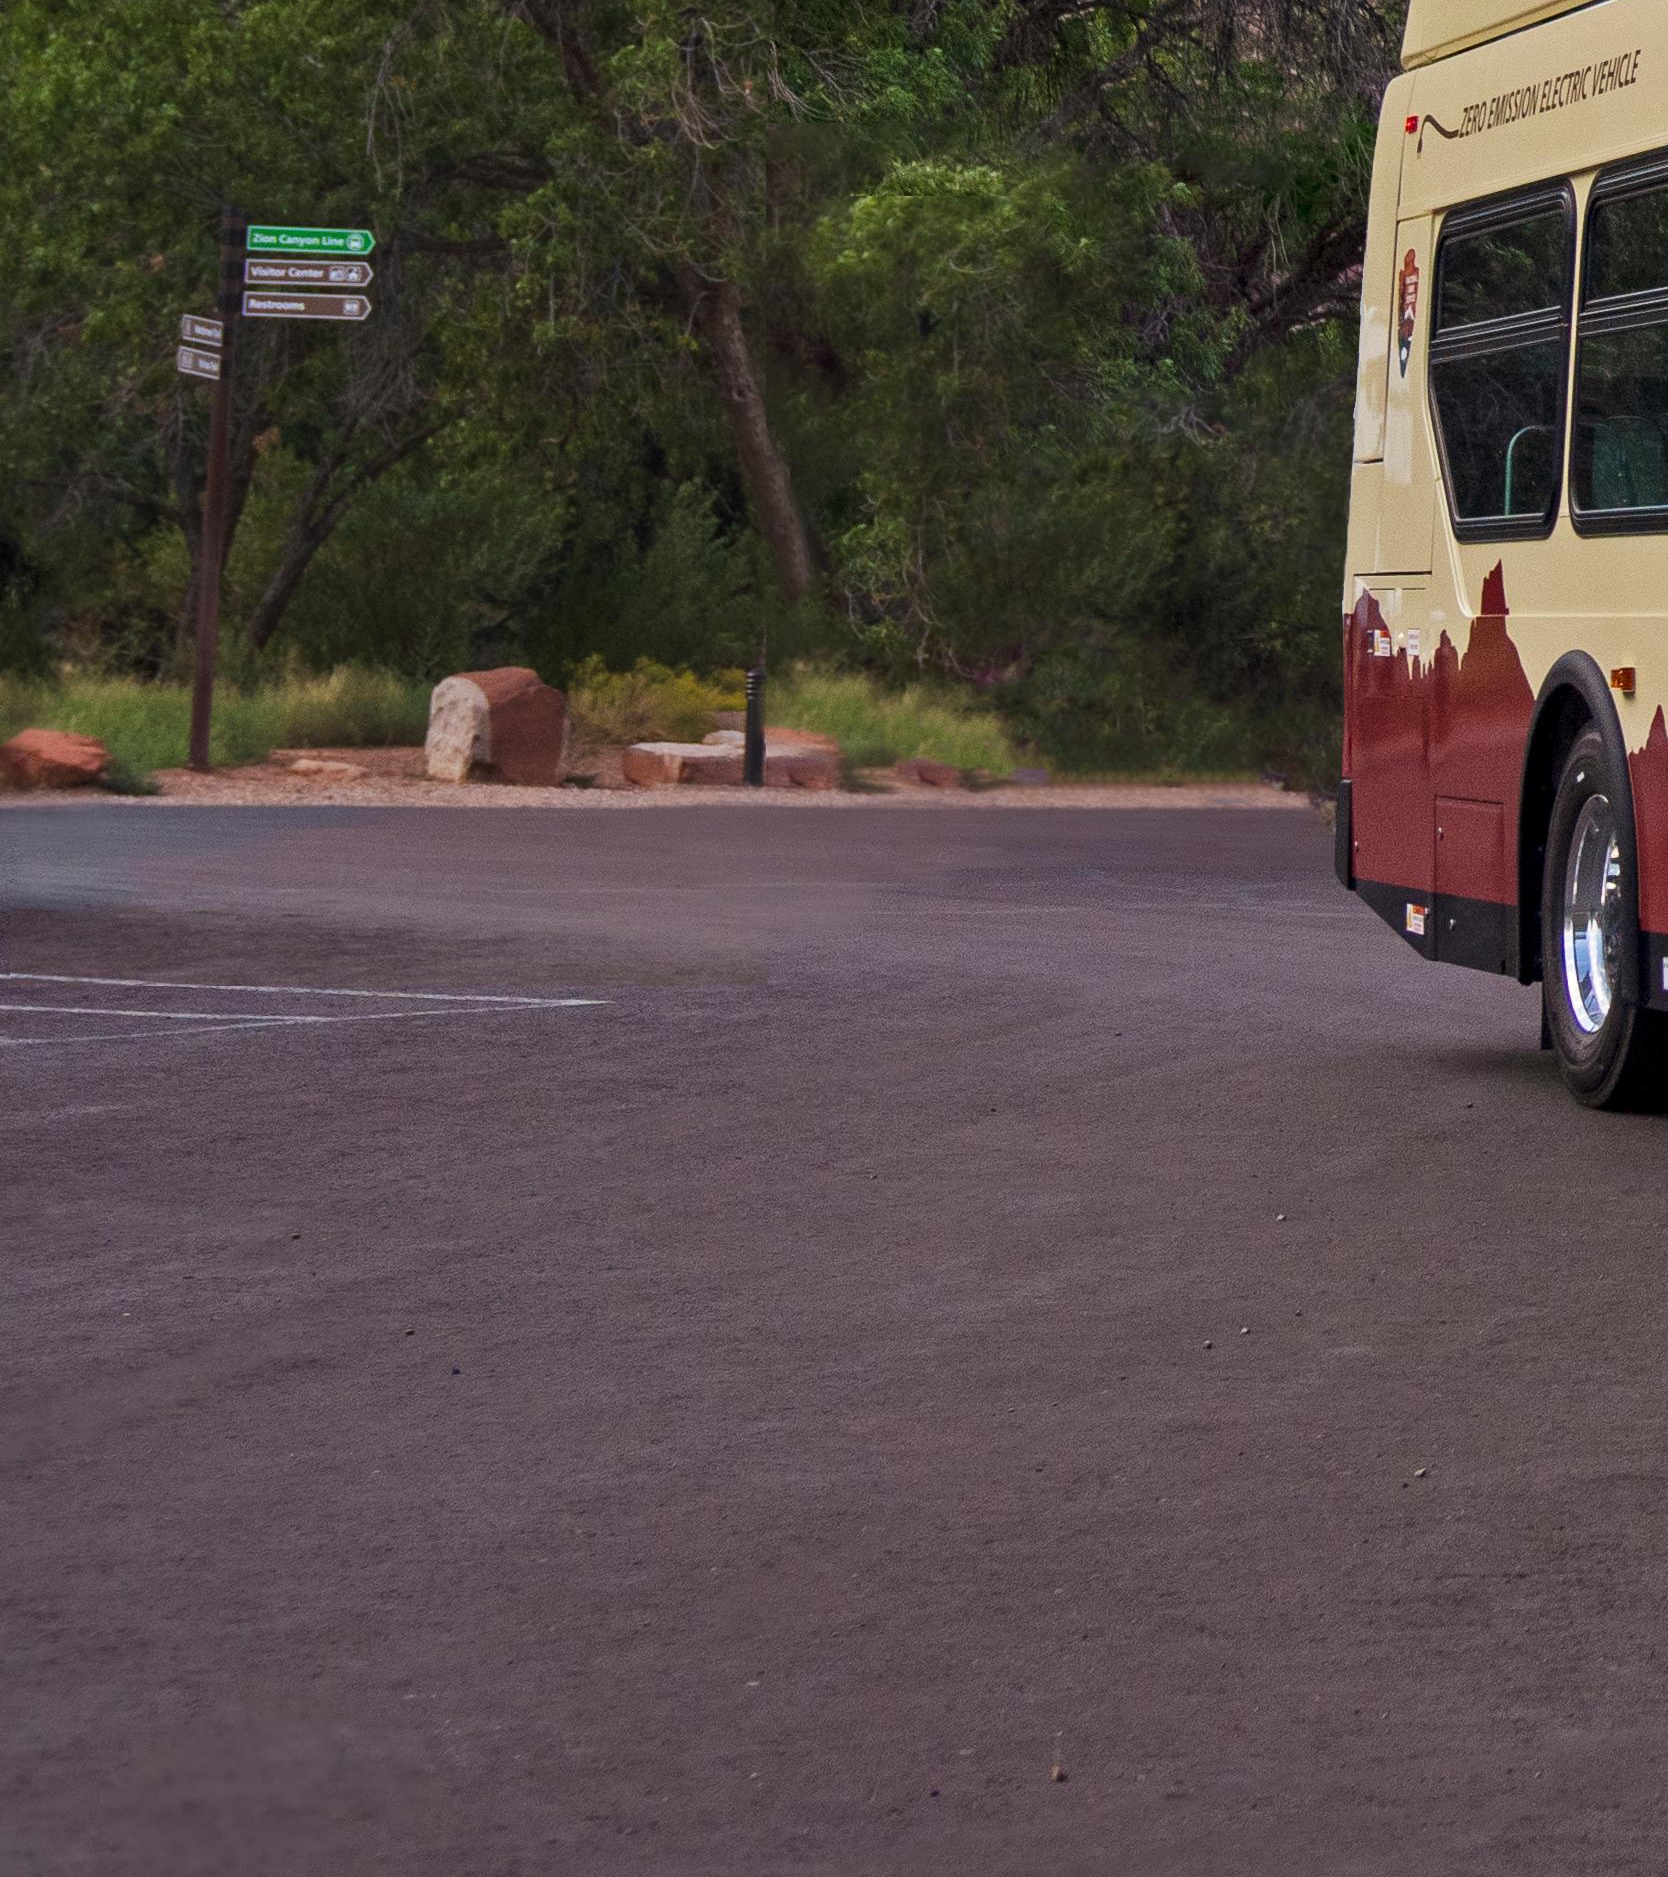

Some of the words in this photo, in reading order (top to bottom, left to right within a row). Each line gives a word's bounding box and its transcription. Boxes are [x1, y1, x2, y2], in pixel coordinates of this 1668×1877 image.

[1458, 101, 1487, 138] ZERO
[1487, 82, 1541, 129] EMISSION
[1539, 66, 1592, 113] ELECTRIC
[1591, 49, 1642, 97] VEHICLE
[253, 232, 277, 244] Zion
[279, 234, 319, 248] Canyon
[321, 236, 344, 246] Line
[250, 266, 286, 277] Visitor
[287, 267, 323, 278] Center
